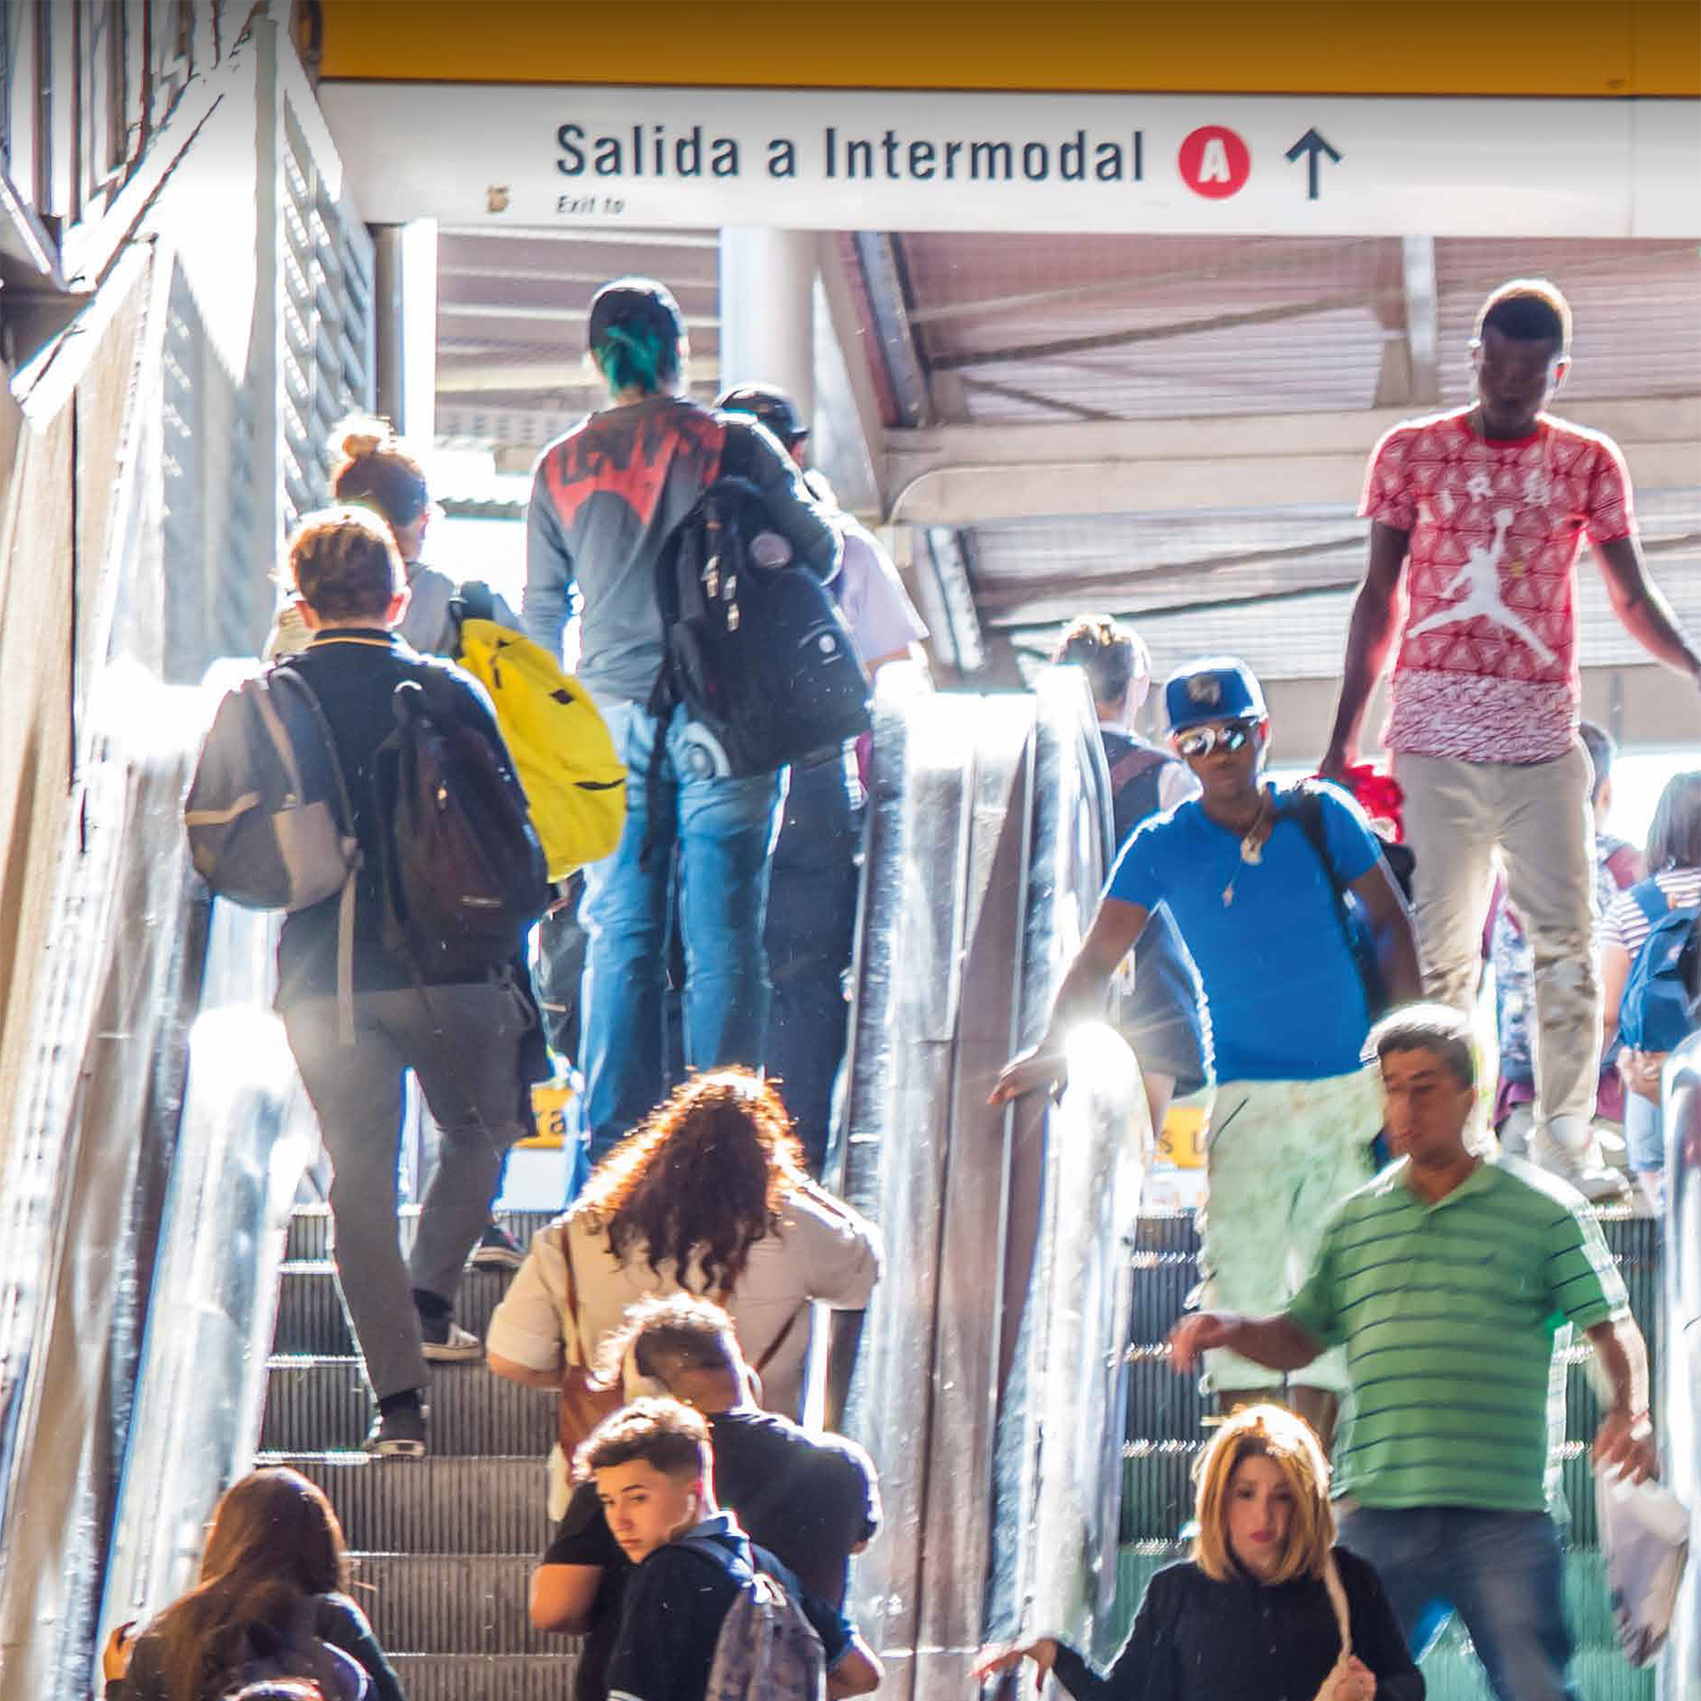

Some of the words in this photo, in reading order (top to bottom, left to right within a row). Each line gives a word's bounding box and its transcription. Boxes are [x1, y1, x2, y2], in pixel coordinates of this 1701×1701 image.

[556, 123, 739, 178] Salida
[767, 138, 797, 178] a
[825, 127, 1145, 182] Intermodal
[1198, 138, 1231, 182] A
[556, 195, 596, 213] Exit
